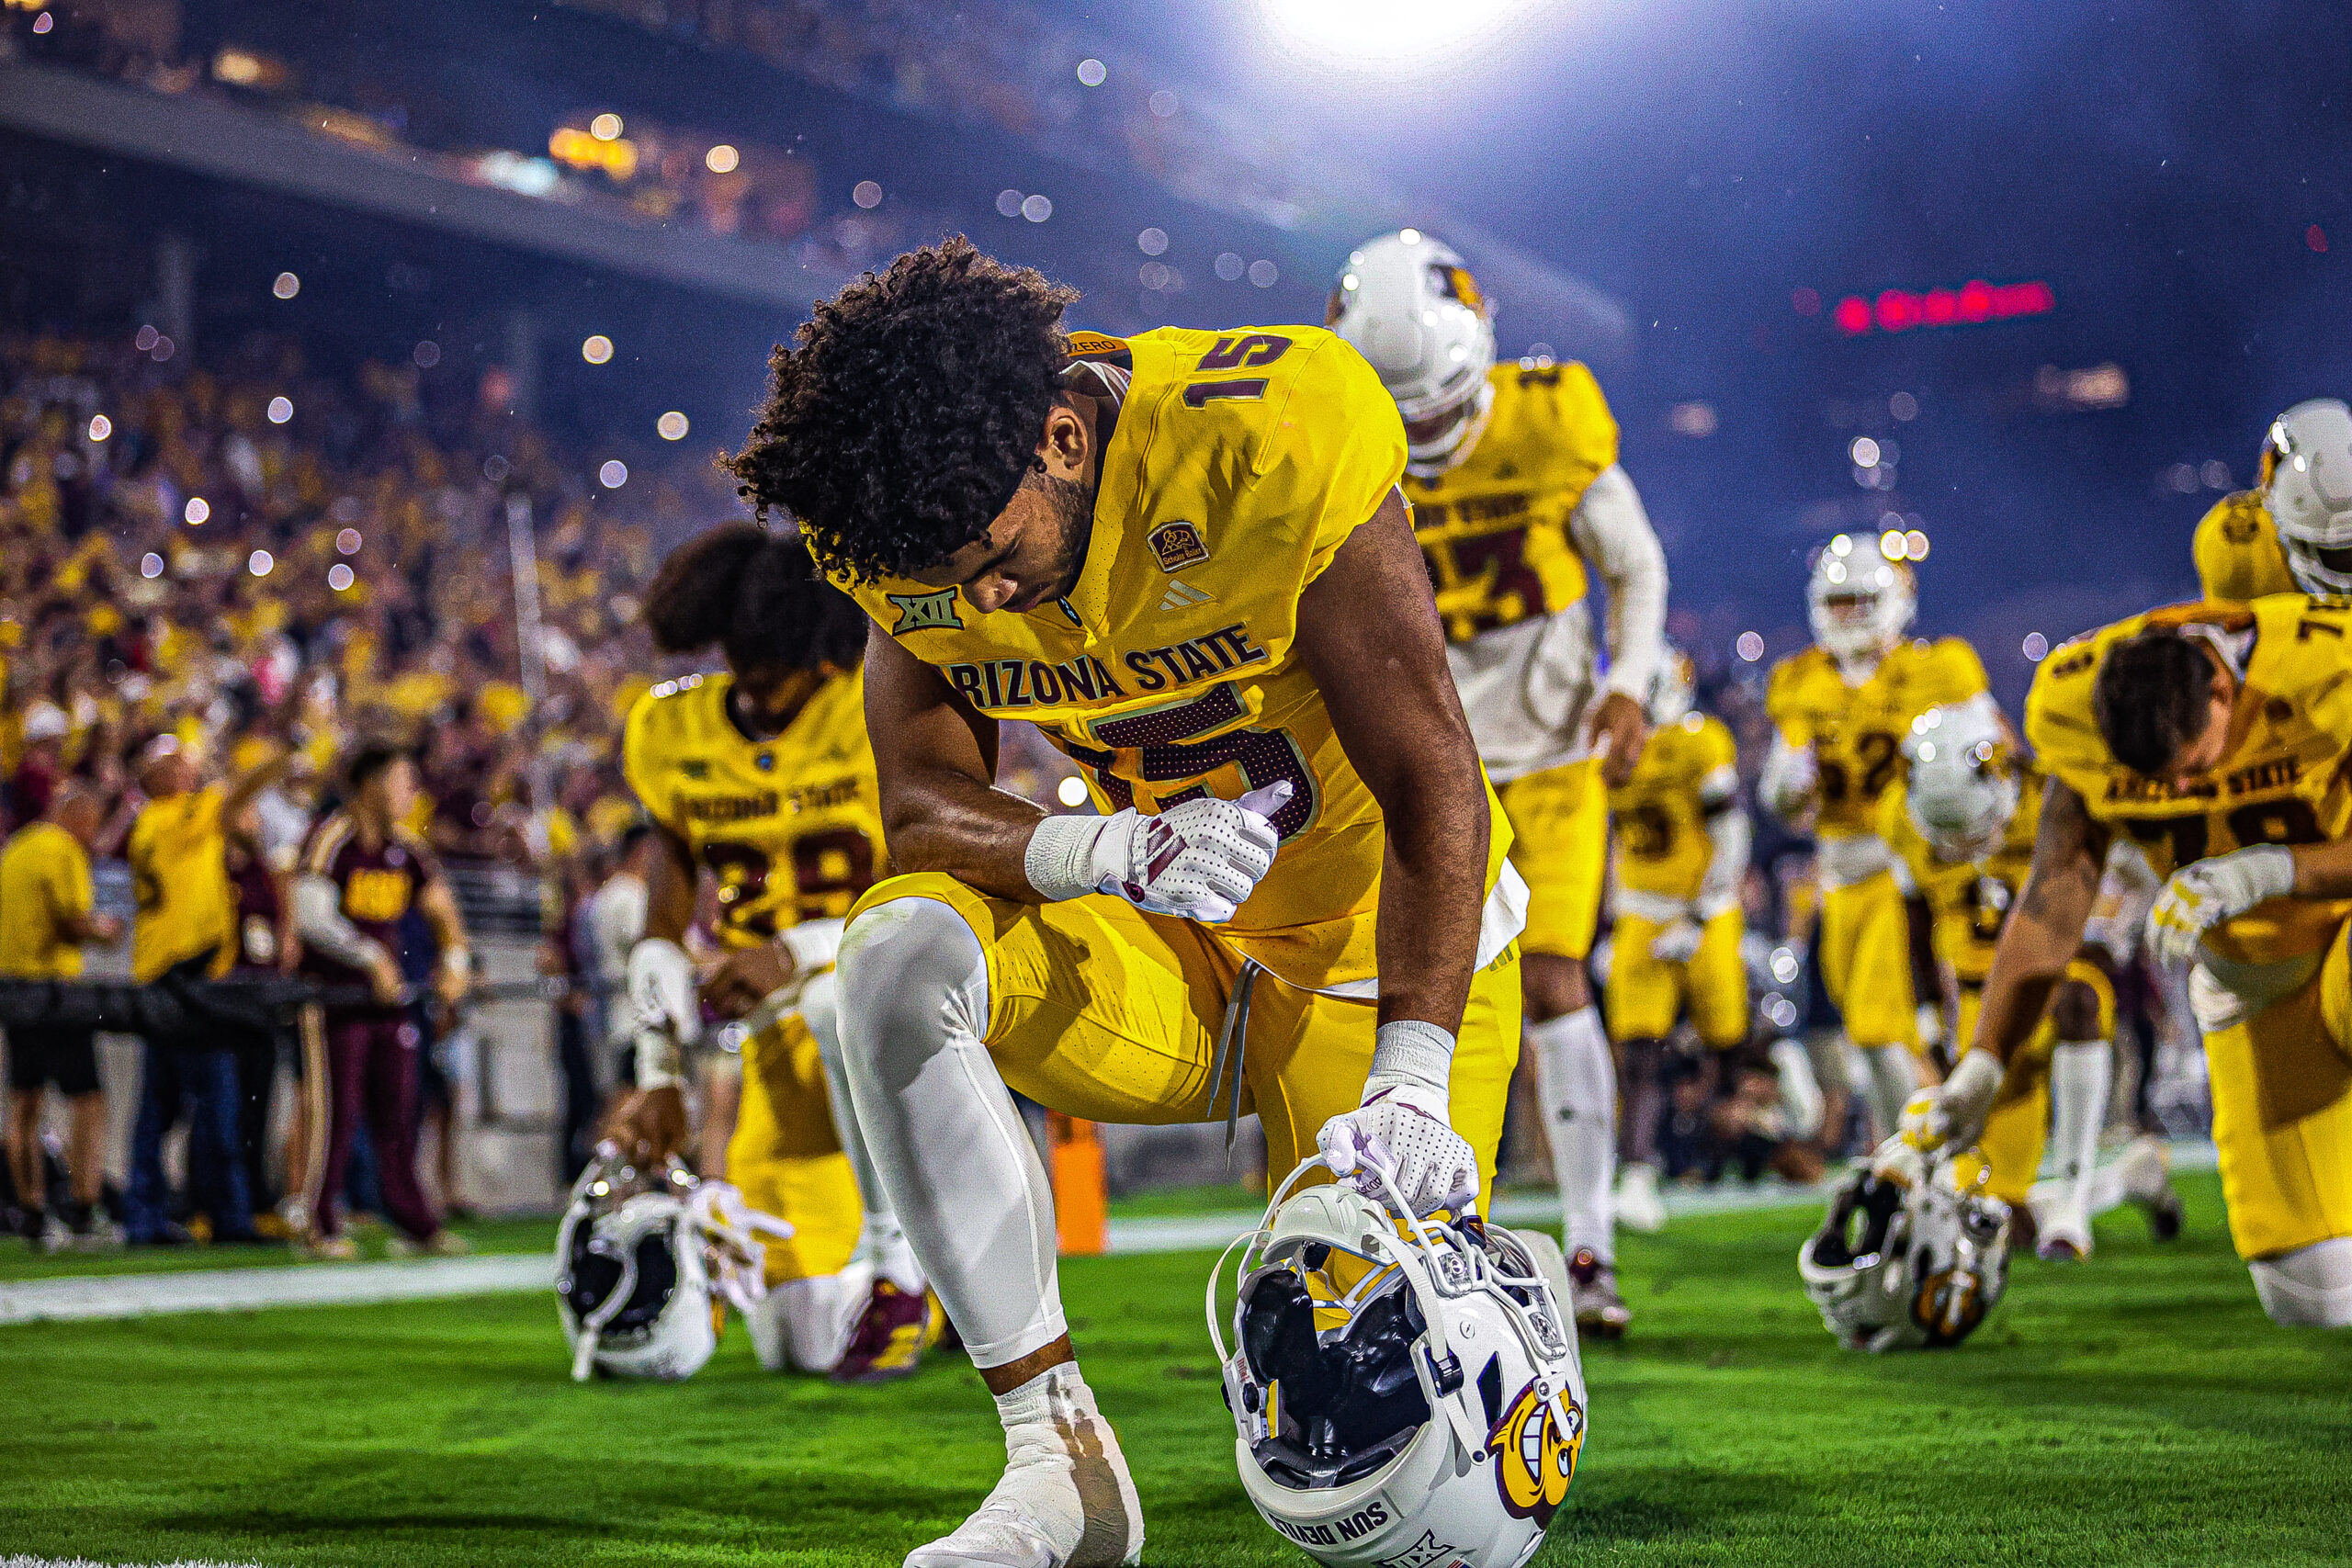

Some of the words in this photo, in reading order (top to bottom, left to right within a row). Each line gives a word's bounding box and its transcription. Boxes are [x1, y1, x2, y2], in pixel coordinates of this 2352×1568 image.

[1182, 334, 1293, 410] 15
[886, 586, 966, 637] XII
[935, 653, 1128, 709] RIZONA
[1125, 622, 1270, 691] STATE
[1267, 1512, 1339, 1546] DEVILS
[1334, 1501, 1389, 1542] SUN
